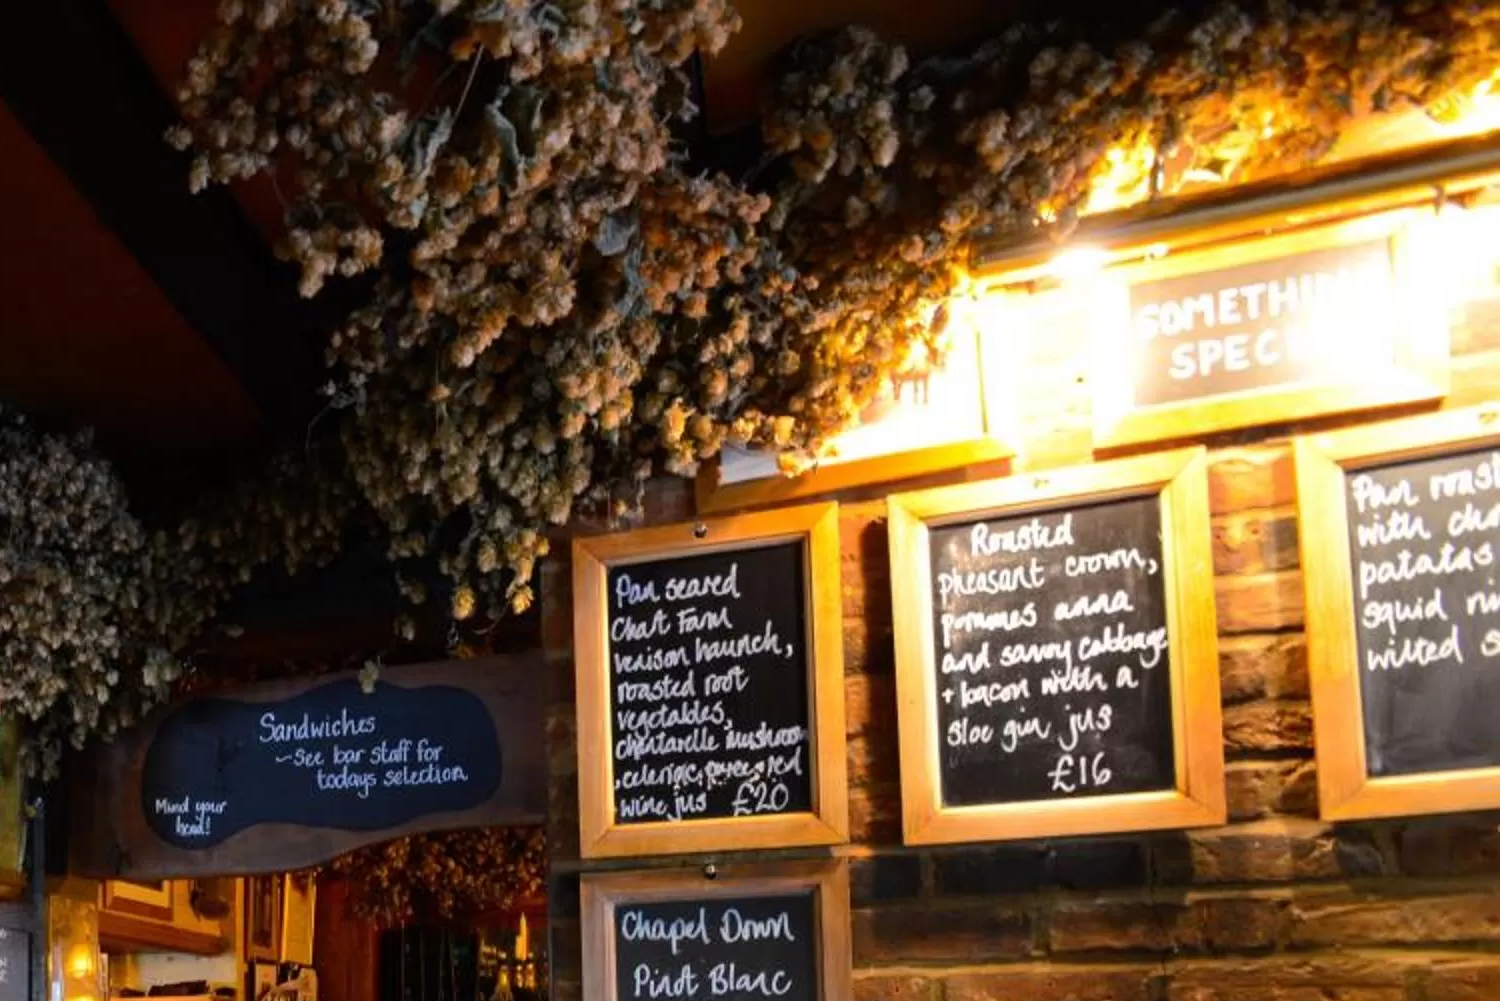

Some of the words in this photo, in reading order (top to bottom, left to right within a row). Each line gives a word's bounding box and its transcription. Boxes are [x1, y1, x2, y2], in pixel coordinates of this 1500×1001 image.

[1352, 473, 1419, 513] Pan
[971, 514, 1074, 557] Roasted
[1357, 512, 1431, 548] with
[616, 574, 660, 608] Pan
[665, 562, 741, 600] seared
[938, 564, 1044, 603] pheasant
[941, 602, 1038, 647] pommes
[1054, 589, 1134, 621] anna
[1363, 590, 1448, 634] squid
[614, 646, 690, 673] venison
[942, 641, 990, 674] and
[1078, 623, 1168, 669] cabbage
[1368, 626, 1463, 672] wilted
[617, 670, 696, 703] roasted
[705, 666, 748, 696] root
[961, 678, 1030, 708] bacon
[1042, 666, 1108, 694] with
[1116, 665, 1139, 688] a
[259, 707, 377, 744] Sandwiches
[1003, 707, 1050, 752] gin
[1059, 704, 1112, 750] jus
[333, 744, 364, 765] bar
[370, 739, 412, 765] staff
[416, 738, 442, 762] for
[768, 747, 802, 777] red
[317, 766, 377, 799] todays
[384, 763, 468, 786] selection
[1048, 752, 1112, 792] £16
[155, 796, 189, 814] Mind
[196, 801, 227, 822] your
[620, 796, 667, 817] wine
[667, 784, 707, 820] jus
[732, 781, 788, 816] £20
[622, 908, 710, 955] Chapel
[720, 908, 794, 942] Down
[634, 963, 699, 998] Pinot
[709, 963, 792, 995] Blanc
